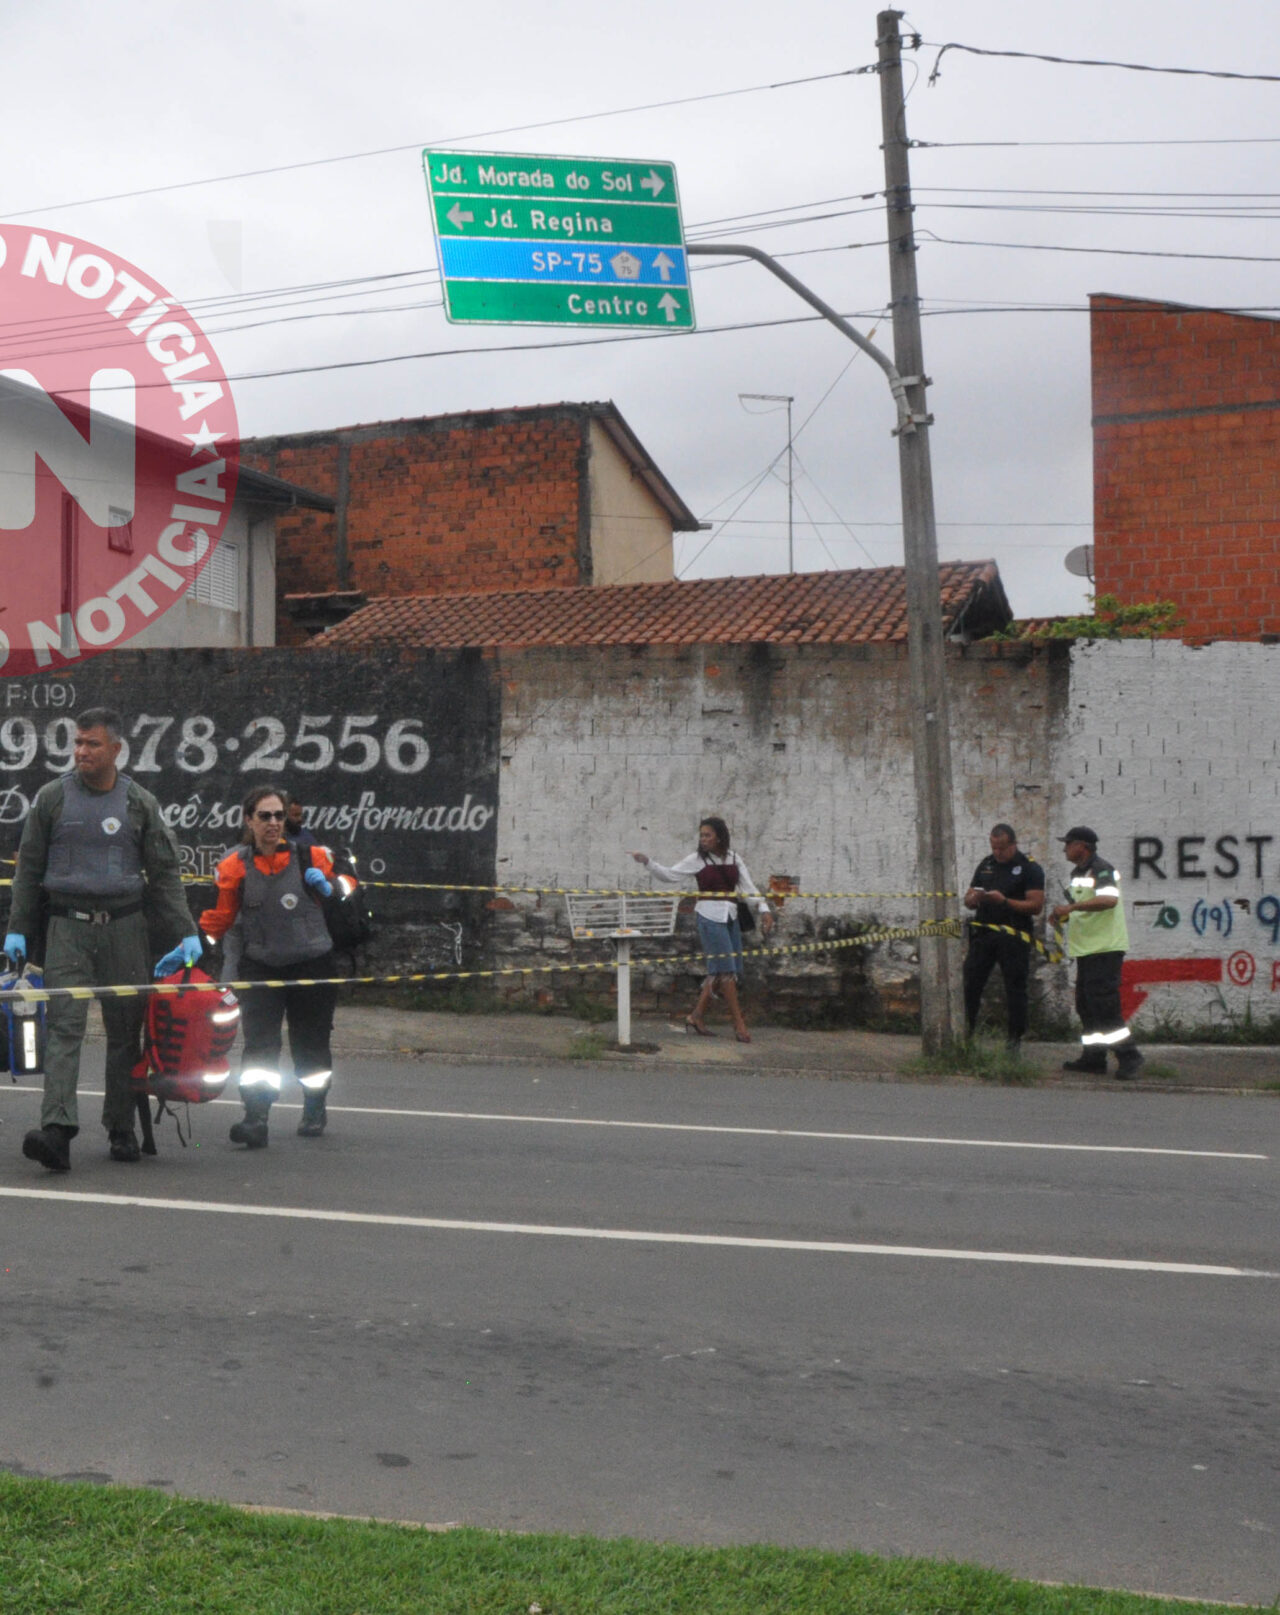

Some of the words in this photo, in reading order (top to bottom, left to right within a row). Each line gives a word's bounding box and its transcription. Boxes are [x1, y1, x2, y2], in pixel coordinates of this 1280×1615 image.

[435, 163, 468, 185] Jd.
[478, 165, 555, 188] Morada
[565, 170, 590, 191] do
[602, 172, 633, 192] Sol
[484, 207, 518, 229] Jd.
[530, 210, 613, 236] Regina
[531, 251, 603, 273] SP-75
[621, 265, 632, 275] 75
[567, 294, 648, 316] Centro
[1132, 835, 1280, 880] REST
[1192, 897, 1233, 938] (19)
